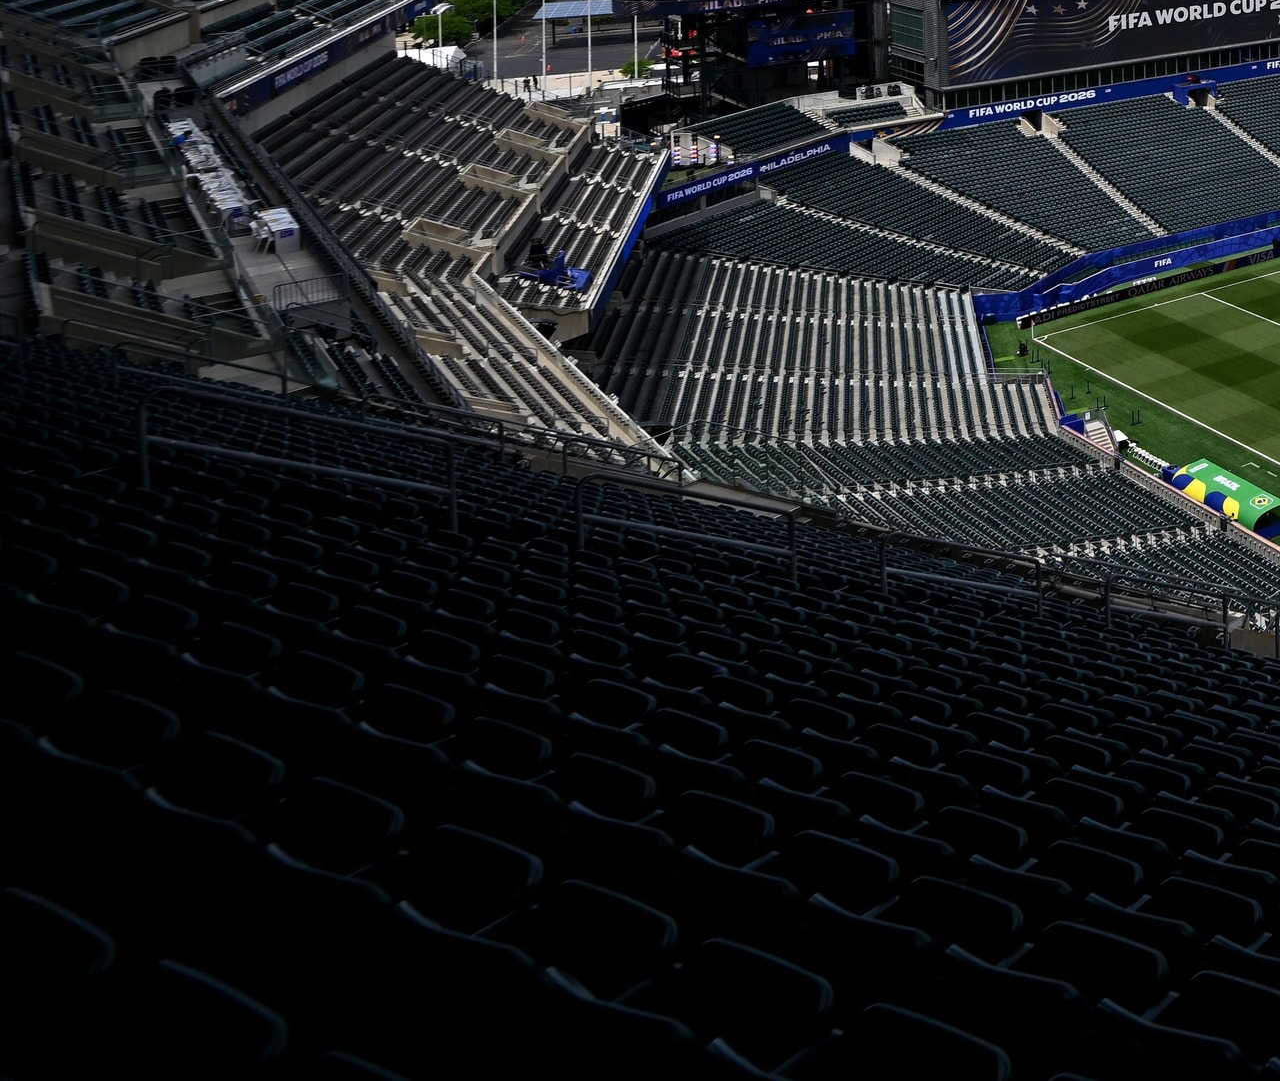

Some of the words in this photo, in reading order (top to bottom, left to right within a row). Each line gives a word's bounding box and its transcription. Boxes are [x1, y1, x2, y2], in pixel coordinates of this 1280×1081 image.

[1109, 13, 1152, 32] FIFA
[1155, 3, 1226, 24] WORLD
[769, 30, 844, 47] HILADPHIA
[969, 107, 993, 118] FIFA
[995, 100, 1034, 113] WORLD
[1037, 96, 1057, 107] CUP
[1059, 90, 1096, 103] 2026
[760, 144, 831, 172] PHILADELPHIA
[668, 188, 684, 202] FIFA
[685, 181, 711, 196] WORLD
[713, 176, 727, 188] CUP
[728, 168, 753, 182] 2026
[1155, 258, 1172, 267] FIFA
[1250, 250, 1274, 264] VISA
[1128, 281, 1165, 297] QATAR
[1169, 268, 1214, 286] AIRWAYS
[1057, 292, 1120, 317] PREDICTSTREET
